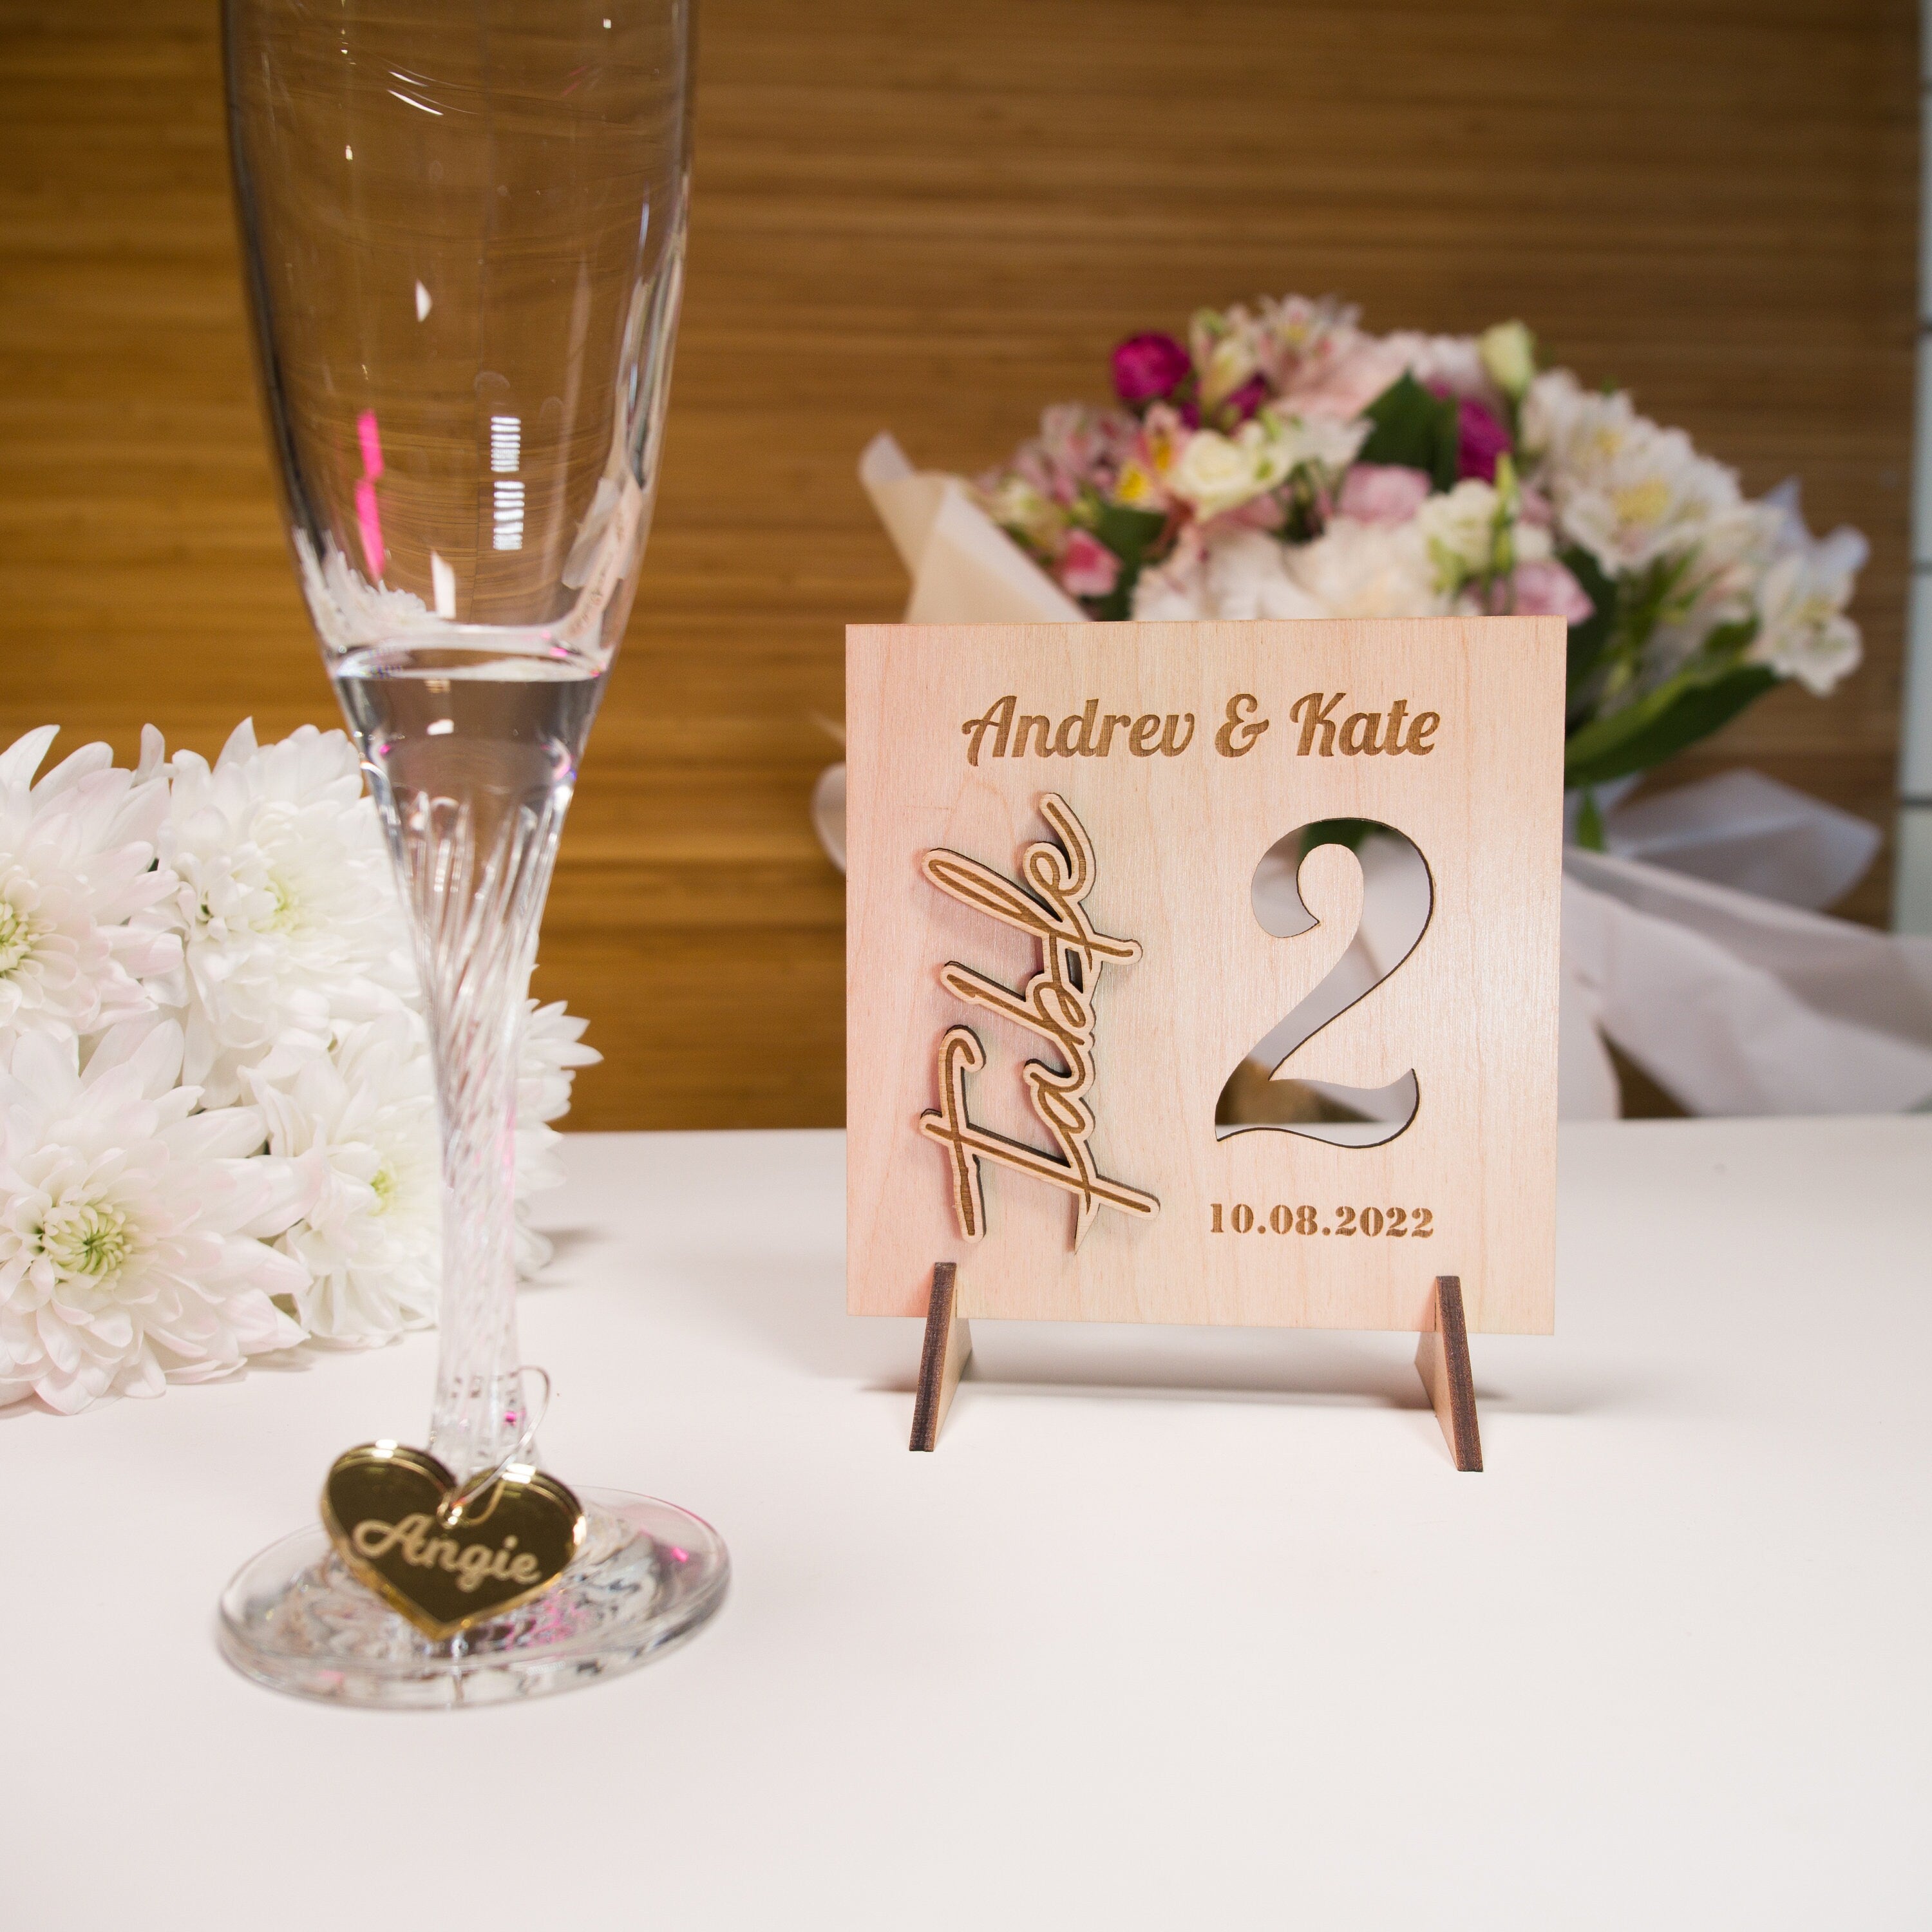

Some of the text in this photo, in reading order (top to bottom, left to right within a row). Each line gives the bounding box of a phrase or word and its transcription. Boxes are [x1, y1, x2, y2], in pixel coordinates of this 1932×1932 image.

[1215, 693, 1269, 758] &
[1289, 692, 1441, 757] Kate
[1215, 817, 1435, 1149] 2
[921, 793, 1160, 1255] Table
[1210, 1203, 1434, 1239] 10.08.2022
[352, 1513, 542, 1593] Angie
